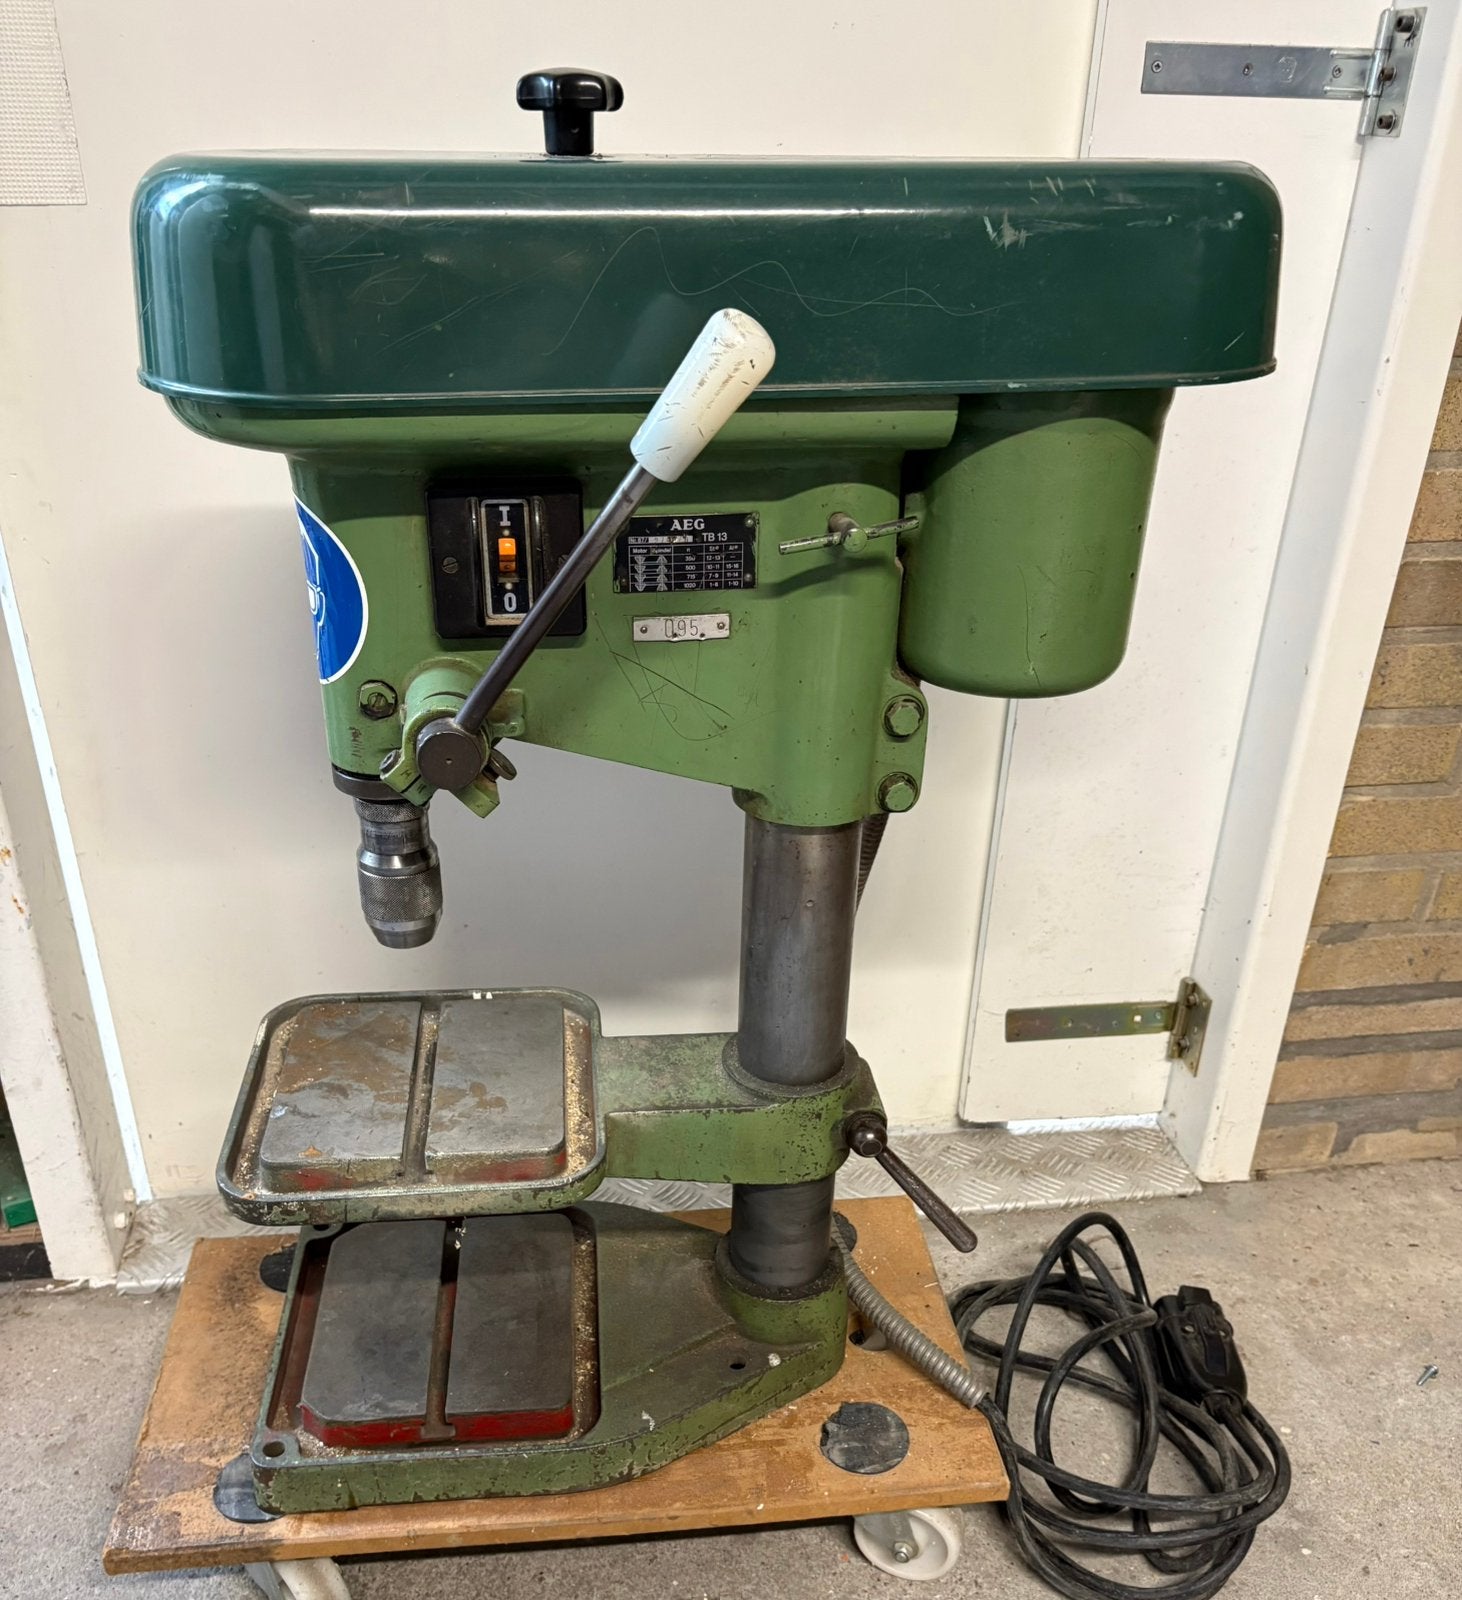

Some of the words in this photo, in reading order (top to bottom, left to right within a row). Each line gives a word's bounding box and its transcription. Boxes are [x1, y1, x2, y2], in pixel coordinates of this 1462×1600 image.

[670, 518, 705, 531] AEG
[702, 532, 715, 542] TB
[717, 532, 728, 541] 13
